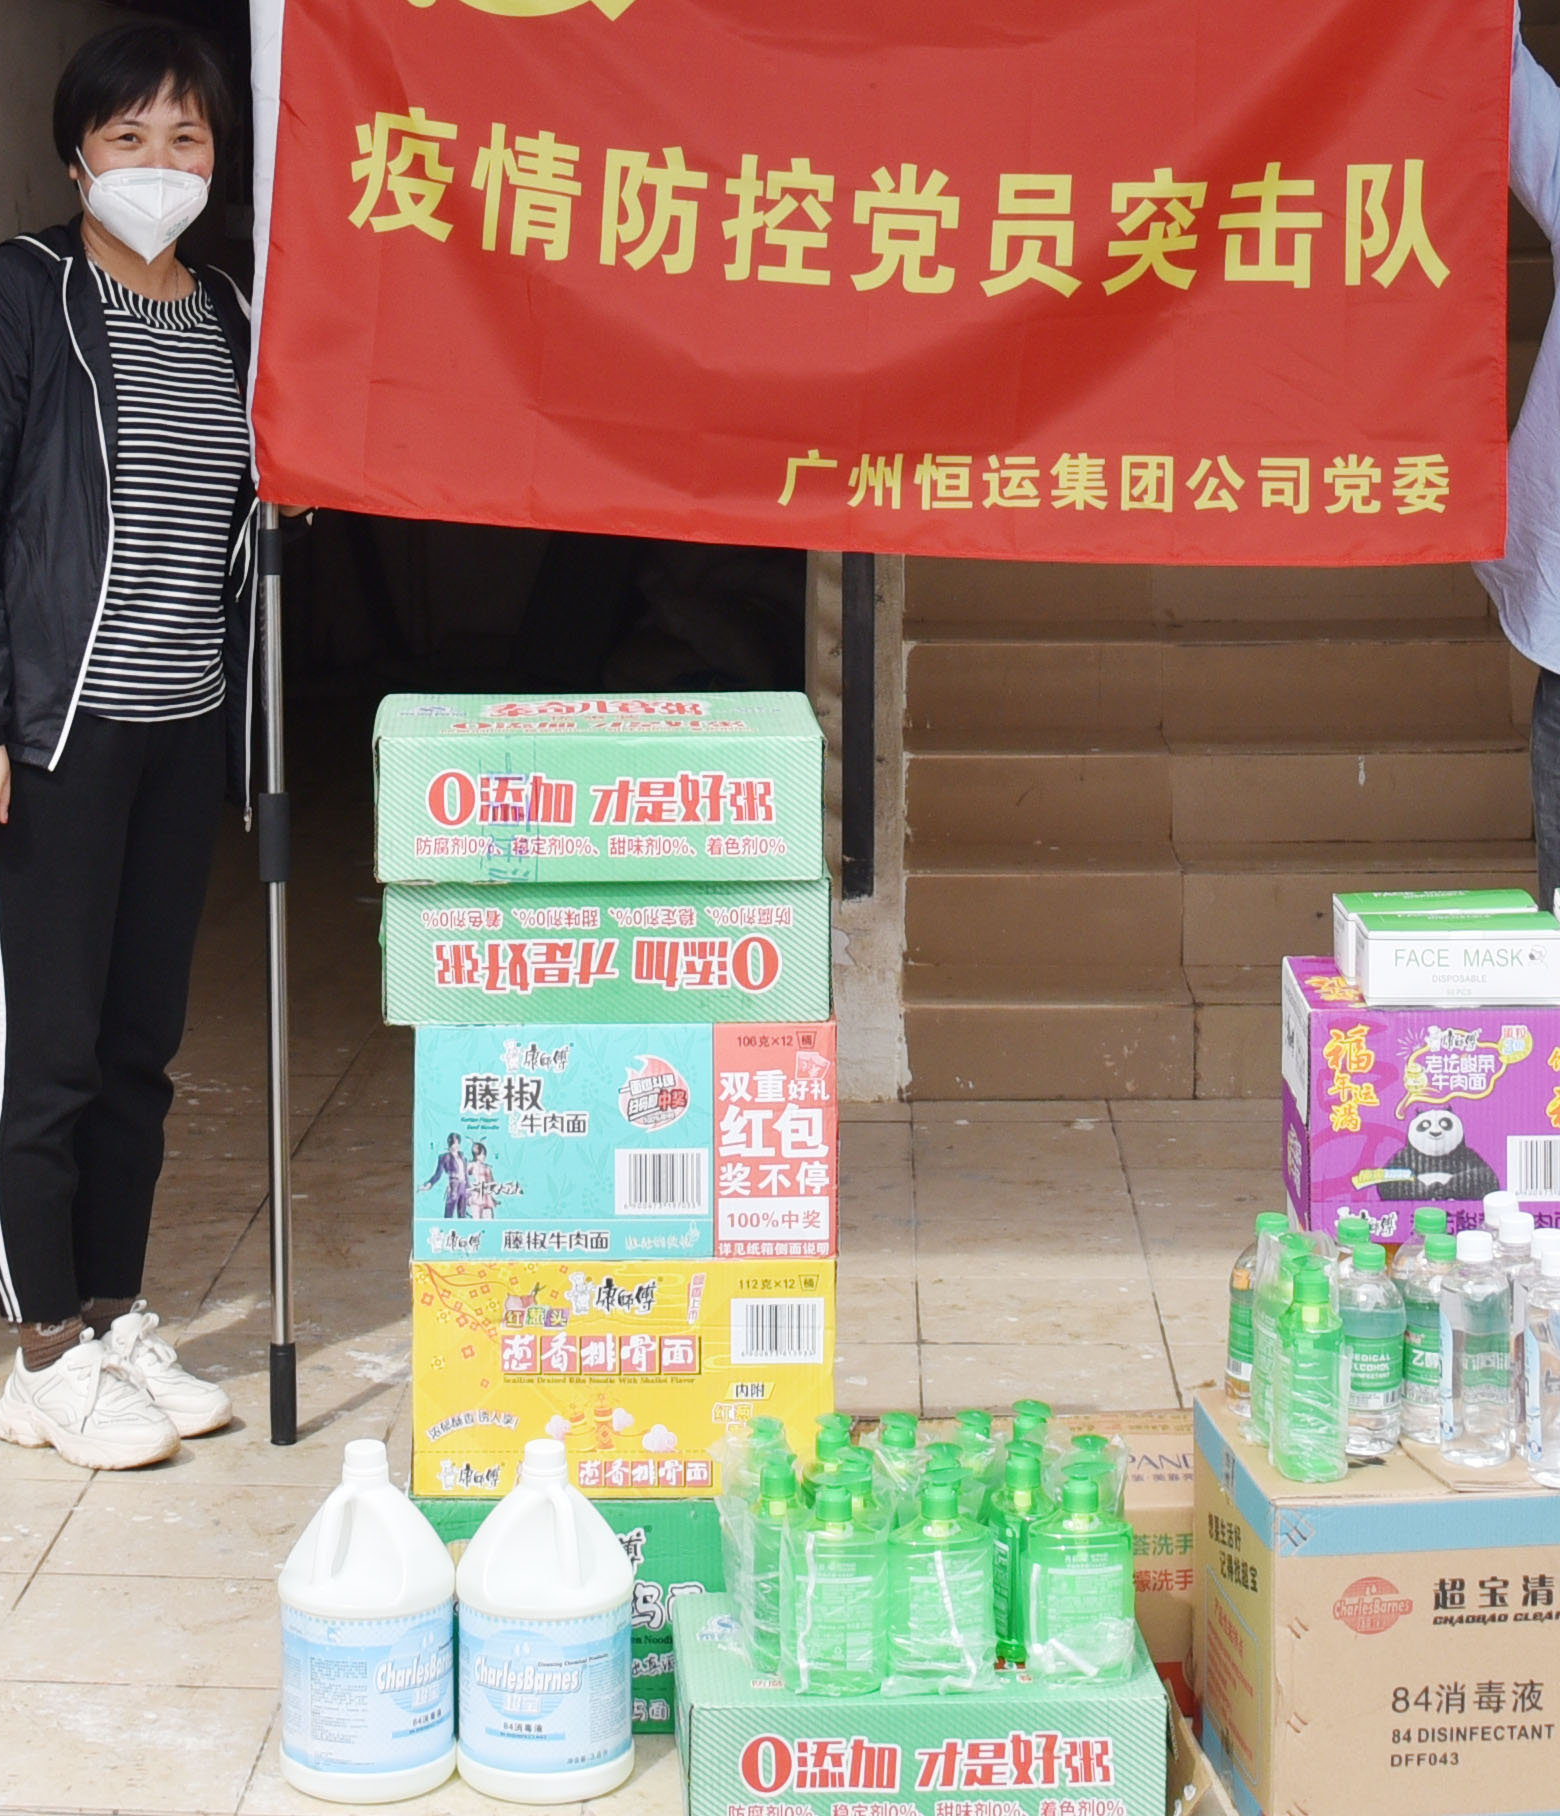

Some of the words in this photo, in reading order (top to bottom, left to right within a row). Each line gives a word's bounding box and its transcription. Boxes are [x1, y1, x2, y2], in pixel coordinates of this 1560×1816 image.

[348, 104, 1453, 299] 疫情防控党员突击队
[776, 448, 1453, 515] 广州恒运集团公司党委
[591, 771, 776, 826] 才是好粥
[435, 939, 619, 993] 才是好粥
[1394, 948, 1449, 968] FACE
[1463, 947, 1524, 967] MASK
[1431, 973, 1488, 984] DISPOSABLE
[1425, 1054, 1496, 1074] 老坛酸菜
[462, 1076, 545, 1113] 藤椒
[1431, 1073, 1487, 1091] 牛肉面
[521, 1113, 588, 1134] 牛肉面
[718, 1103, 830, 1159] 红包
[719, 1162, 831, 1196] 奖不停
[727, 1209, 822, 1230] 100%中奖
[504, 1231, 610, 1251] 藤椒牛肉面
[474, 1654, 581, 1693] CharlesBarnes
[1390, 1679, 1545, 1716] 84消毒液
[1391, 1728, 1413, 1744] 84
[1417, 1723, 1556, 1743] DISINFECTANT
[916, 1731, 1116, 1791] 才是好粥
[1390, 1751, 1460, 1768] DFF043
